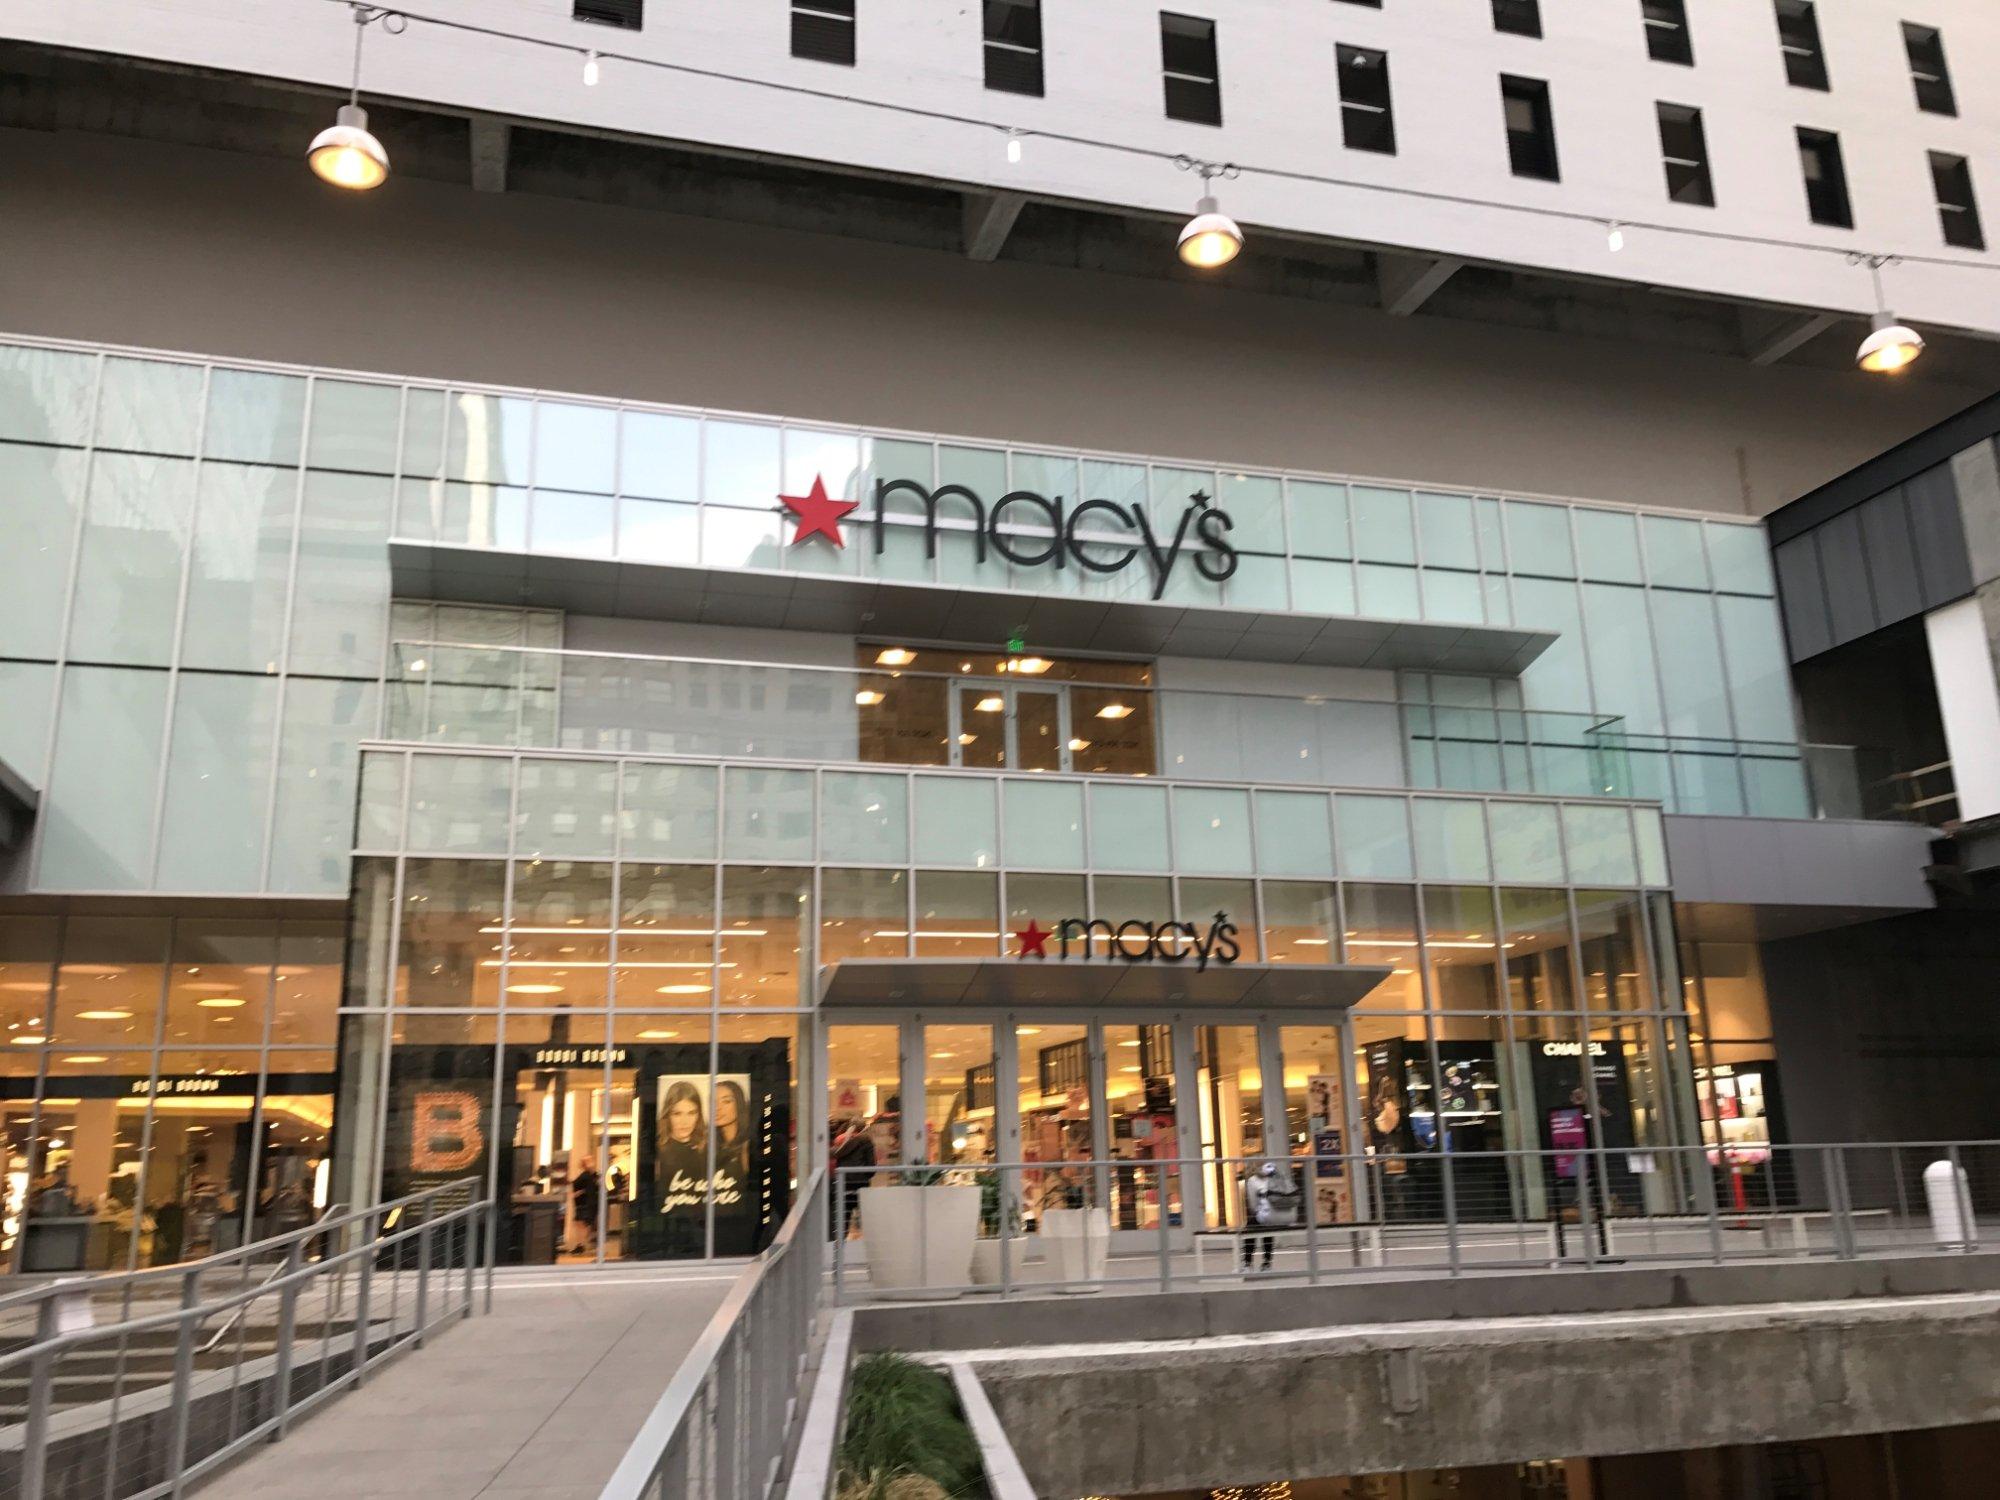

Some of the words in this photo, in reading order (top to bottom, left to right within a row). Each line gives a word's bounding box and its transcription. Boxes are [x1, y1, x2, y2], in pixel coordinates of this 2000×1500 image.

[410, 1091, 484, 1172] B
[669, 1168, 695, 1193] be
[660, 1192, 702, 1214] you
